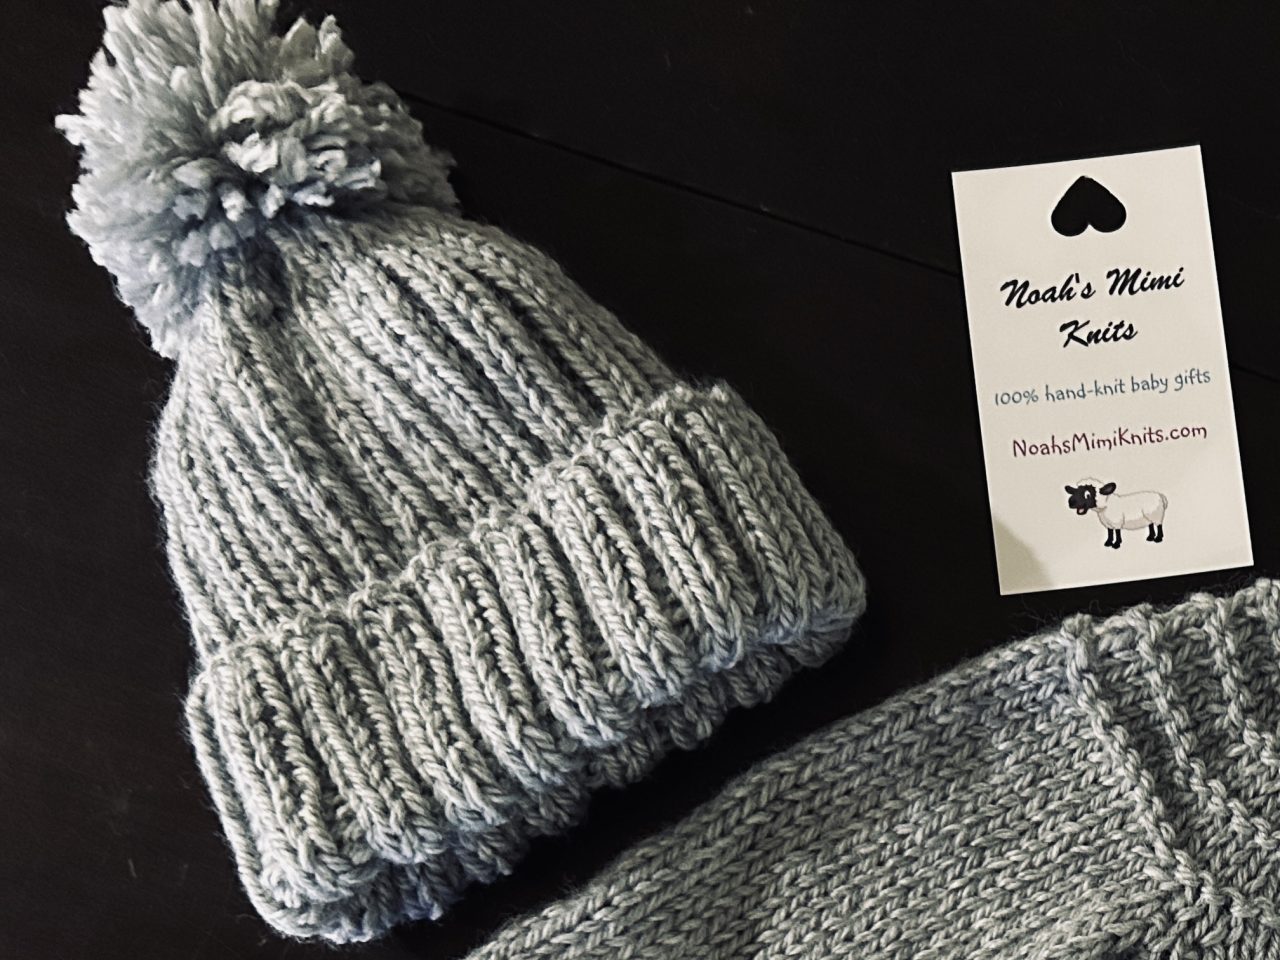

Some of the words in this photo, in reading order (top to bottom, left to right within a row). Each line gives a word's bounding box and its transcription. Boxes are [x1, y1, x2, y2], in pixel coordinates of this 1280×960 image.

[1000, 273, 1096, 309] Noah's
[1106, 267, 1185, 296] Mimi
[1059, 319, 1138, 348] Knits
[994, 388, 1039, 406] 100%
[1045, 378, 1126, 403] hand-knit
[1131, 373, 1169, 393] baby
[1174, 368, 1211, 392] gifts
[1012, 425, 1208, 457] NoahsMimiKnits.com
